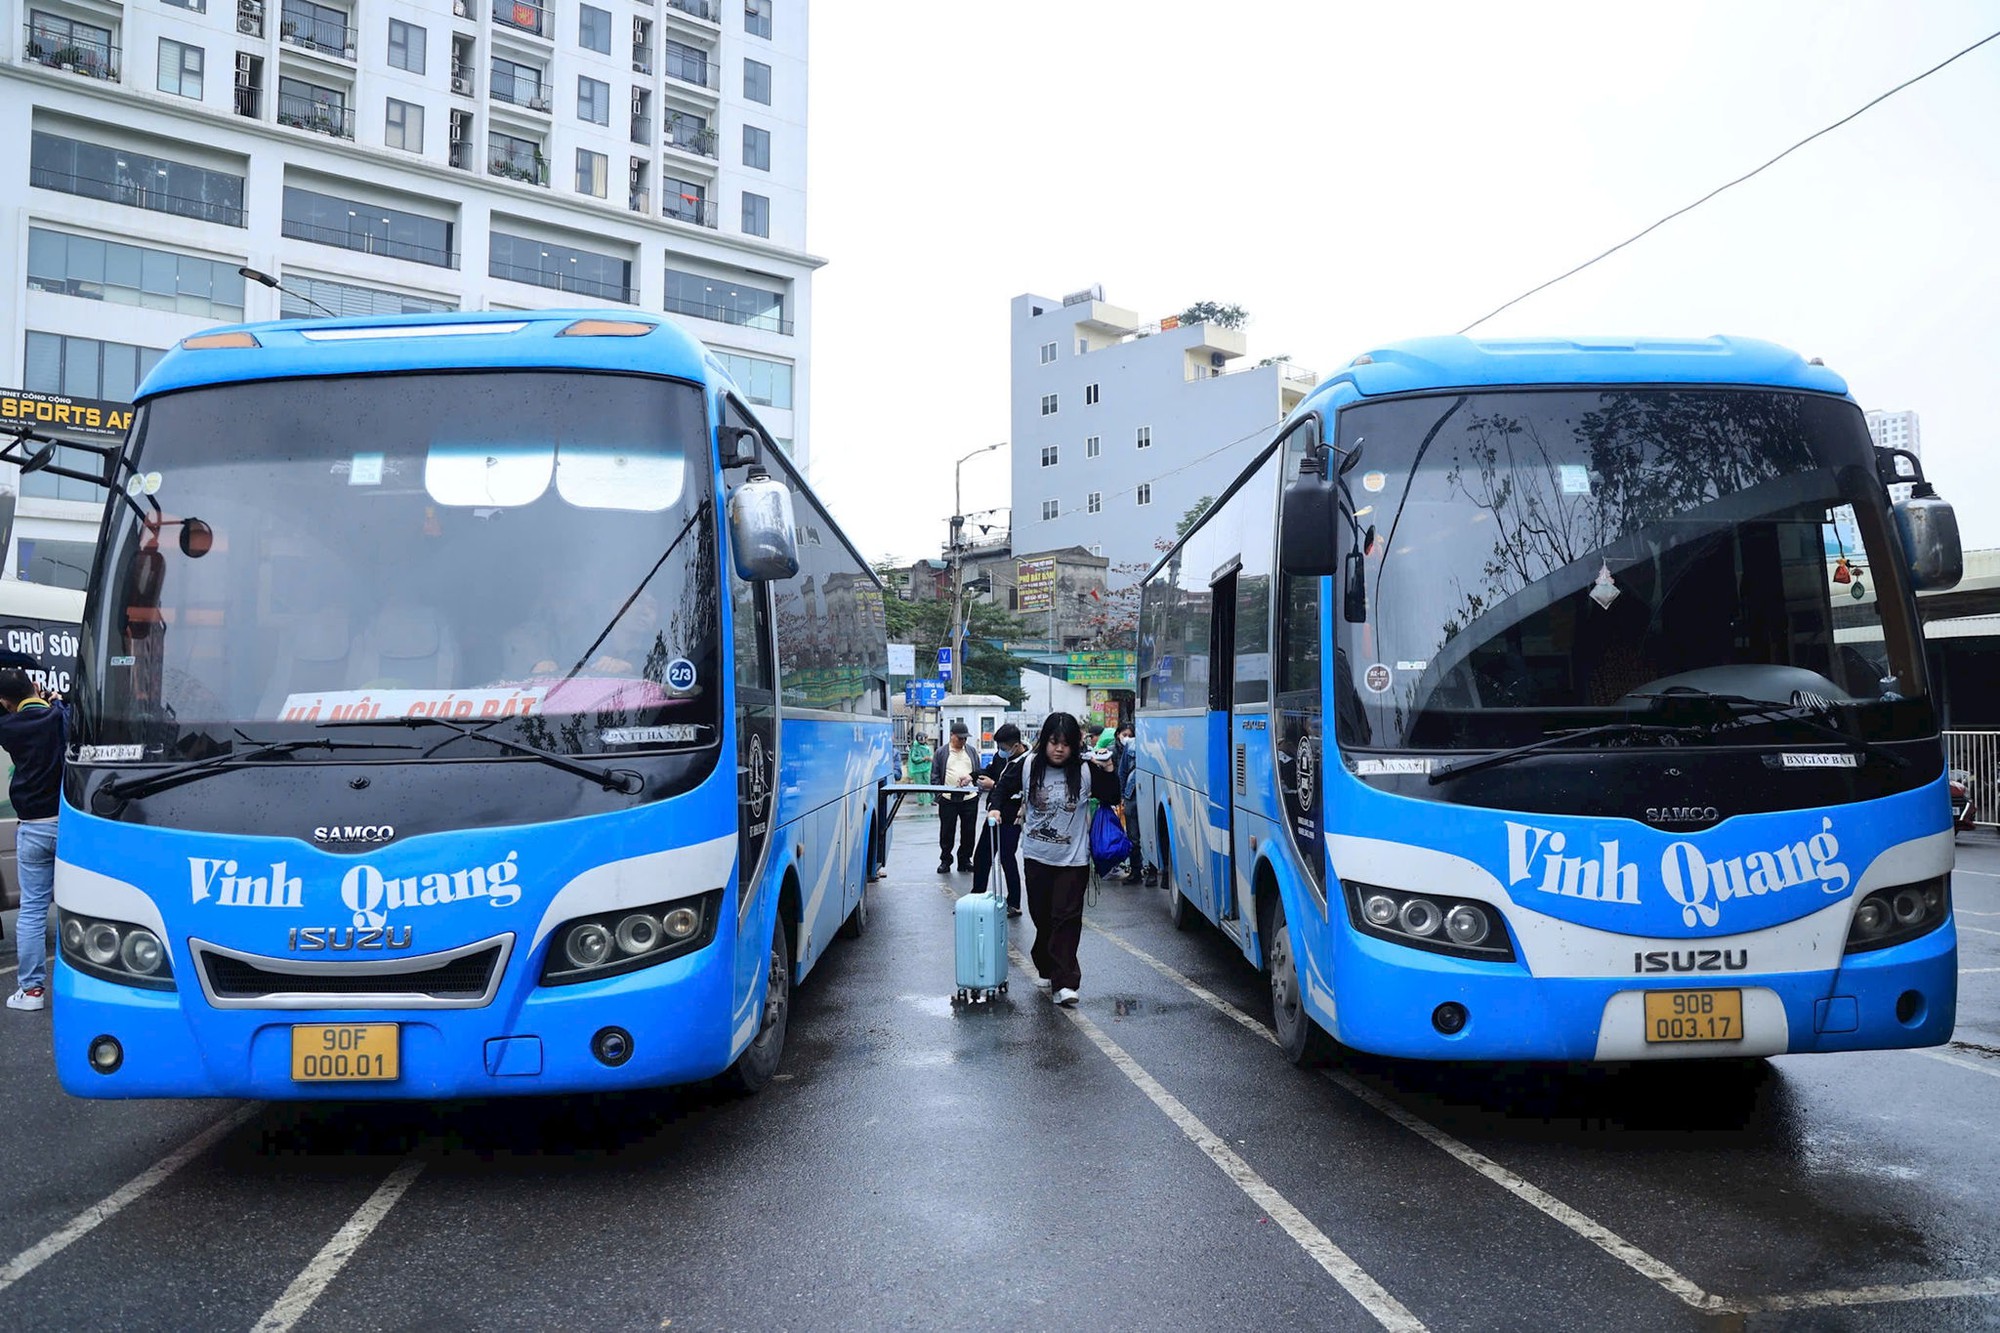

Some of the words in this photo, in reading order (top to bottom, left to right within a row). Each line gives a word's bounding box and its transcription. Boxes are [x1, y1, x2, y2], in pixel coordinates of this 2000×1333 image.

[2, 397, 101, 427] SPORTS
[8, 629, 45, 660] CHỢ
[671, 668, 692, 681] 2/3
[930, 689, 937, 699] 2
[1646, 806, 1720, 823] SAMCO
[313, 825, 395, 843] SAMCO
[1503, 820, 1643, 906] Vinh
[1660, 816, 1851, 928] Quang
[188, 856, 304, 909] Vinh
[340, 850, 523, 928] Quang
[288, 925, 413, 952] ISUZU
[1634, 948, 1749, 974] ISUZU
[1672, 993, 1715, 1015] 90B
[322, 1028, 368, 1051] 90F
[1656, 1017, 1732, 1039] 003.17
[303, 1054, 385, 1078] 000.01
